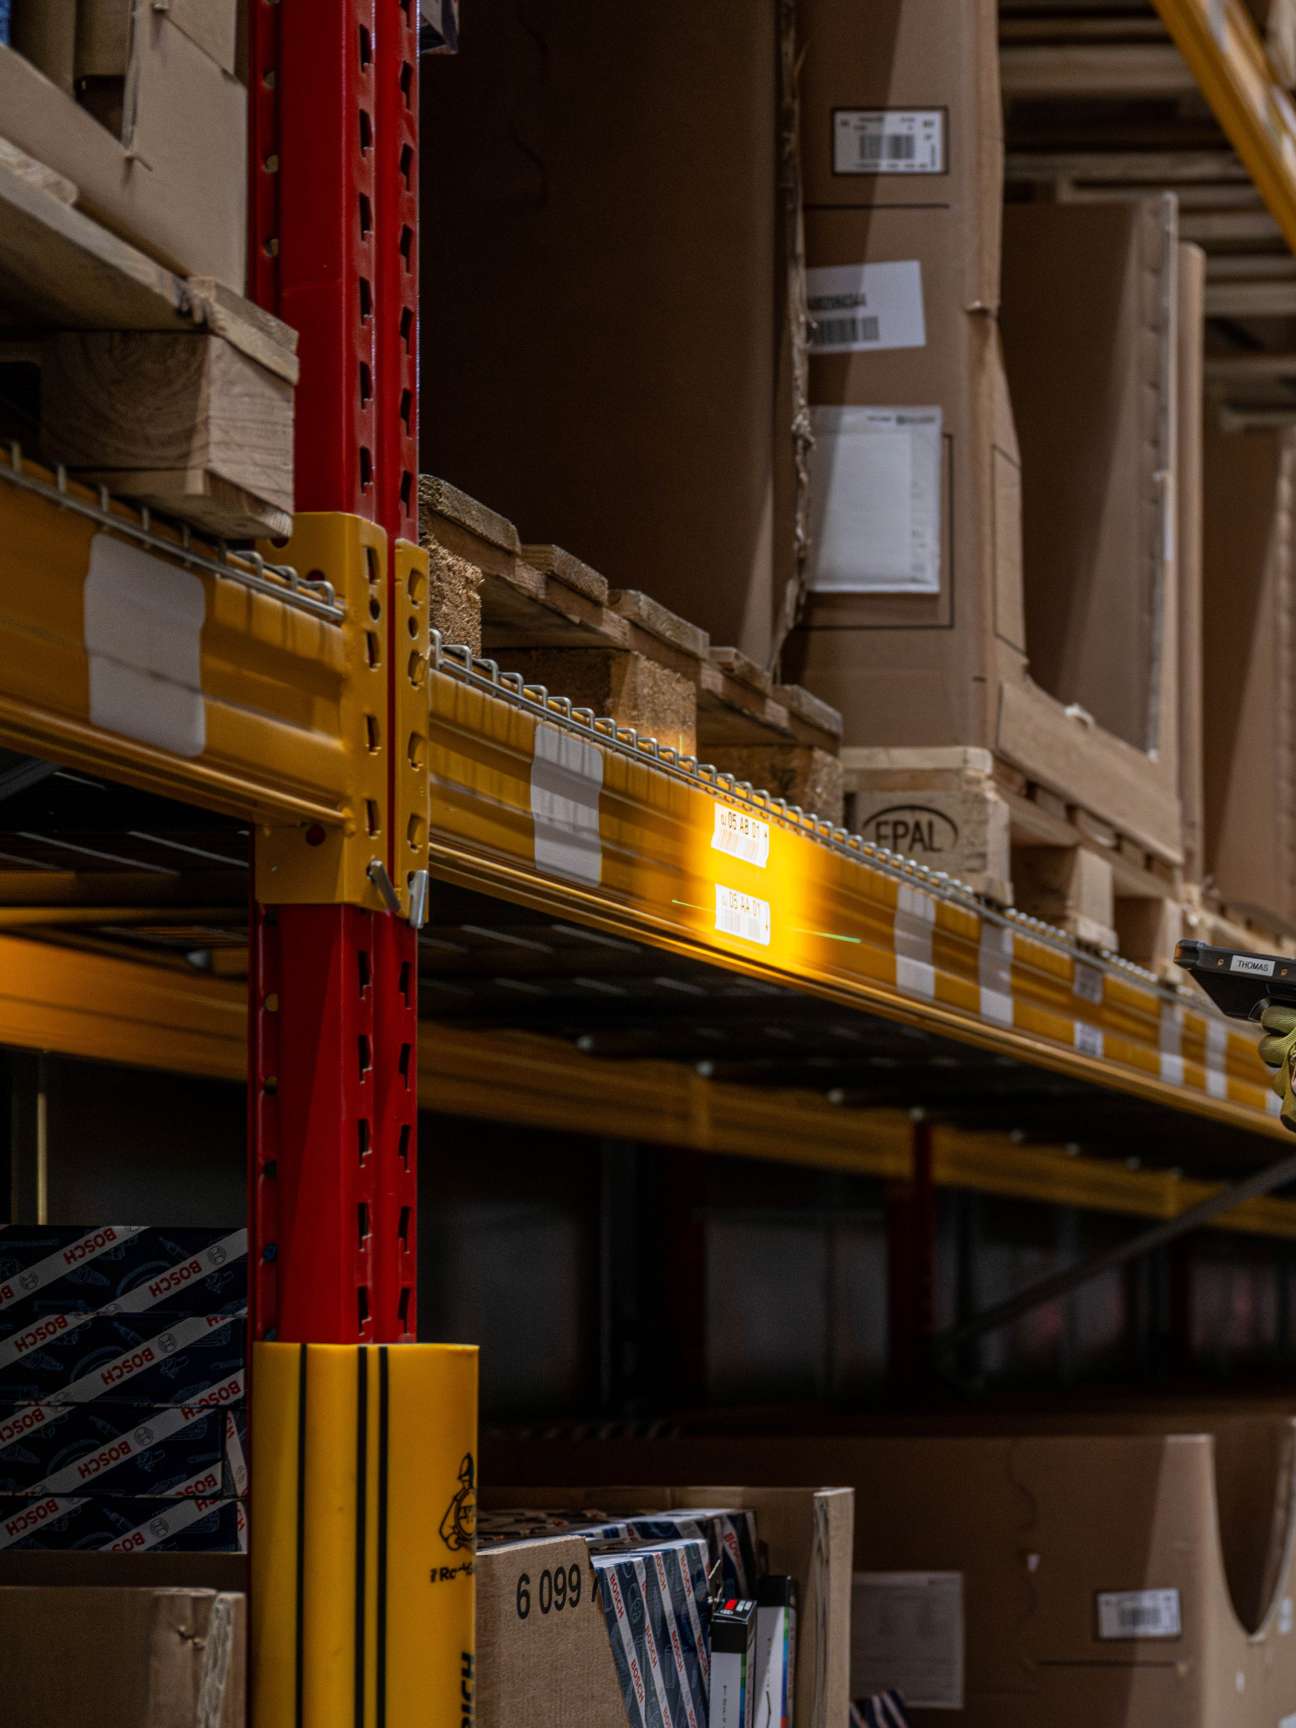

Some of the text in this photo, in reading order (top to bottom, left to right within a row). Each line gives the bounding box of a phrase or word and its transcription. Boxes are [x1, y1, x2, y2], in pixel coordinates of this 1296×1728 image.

[1238, 960, 1269, 972] THOMAS
[63, 1227, 117, 1265] BOSCH
[149, 1260, 202, 1297] BOSCH
[14, 1315, 68, 1352] BOSCH
[101, 1348, 155, 1385] BOSCH
[78, 1441, 131, 1478] BOSCH
[6, 1500, 59, 1537] BOSCH
[517, 1573, 530, 1619] 6
[539, 1563, 581, 1615] 099
[610, 1574, 624, 1618] BOSCH
[631, 1660, 645, 1702] BOSCH
